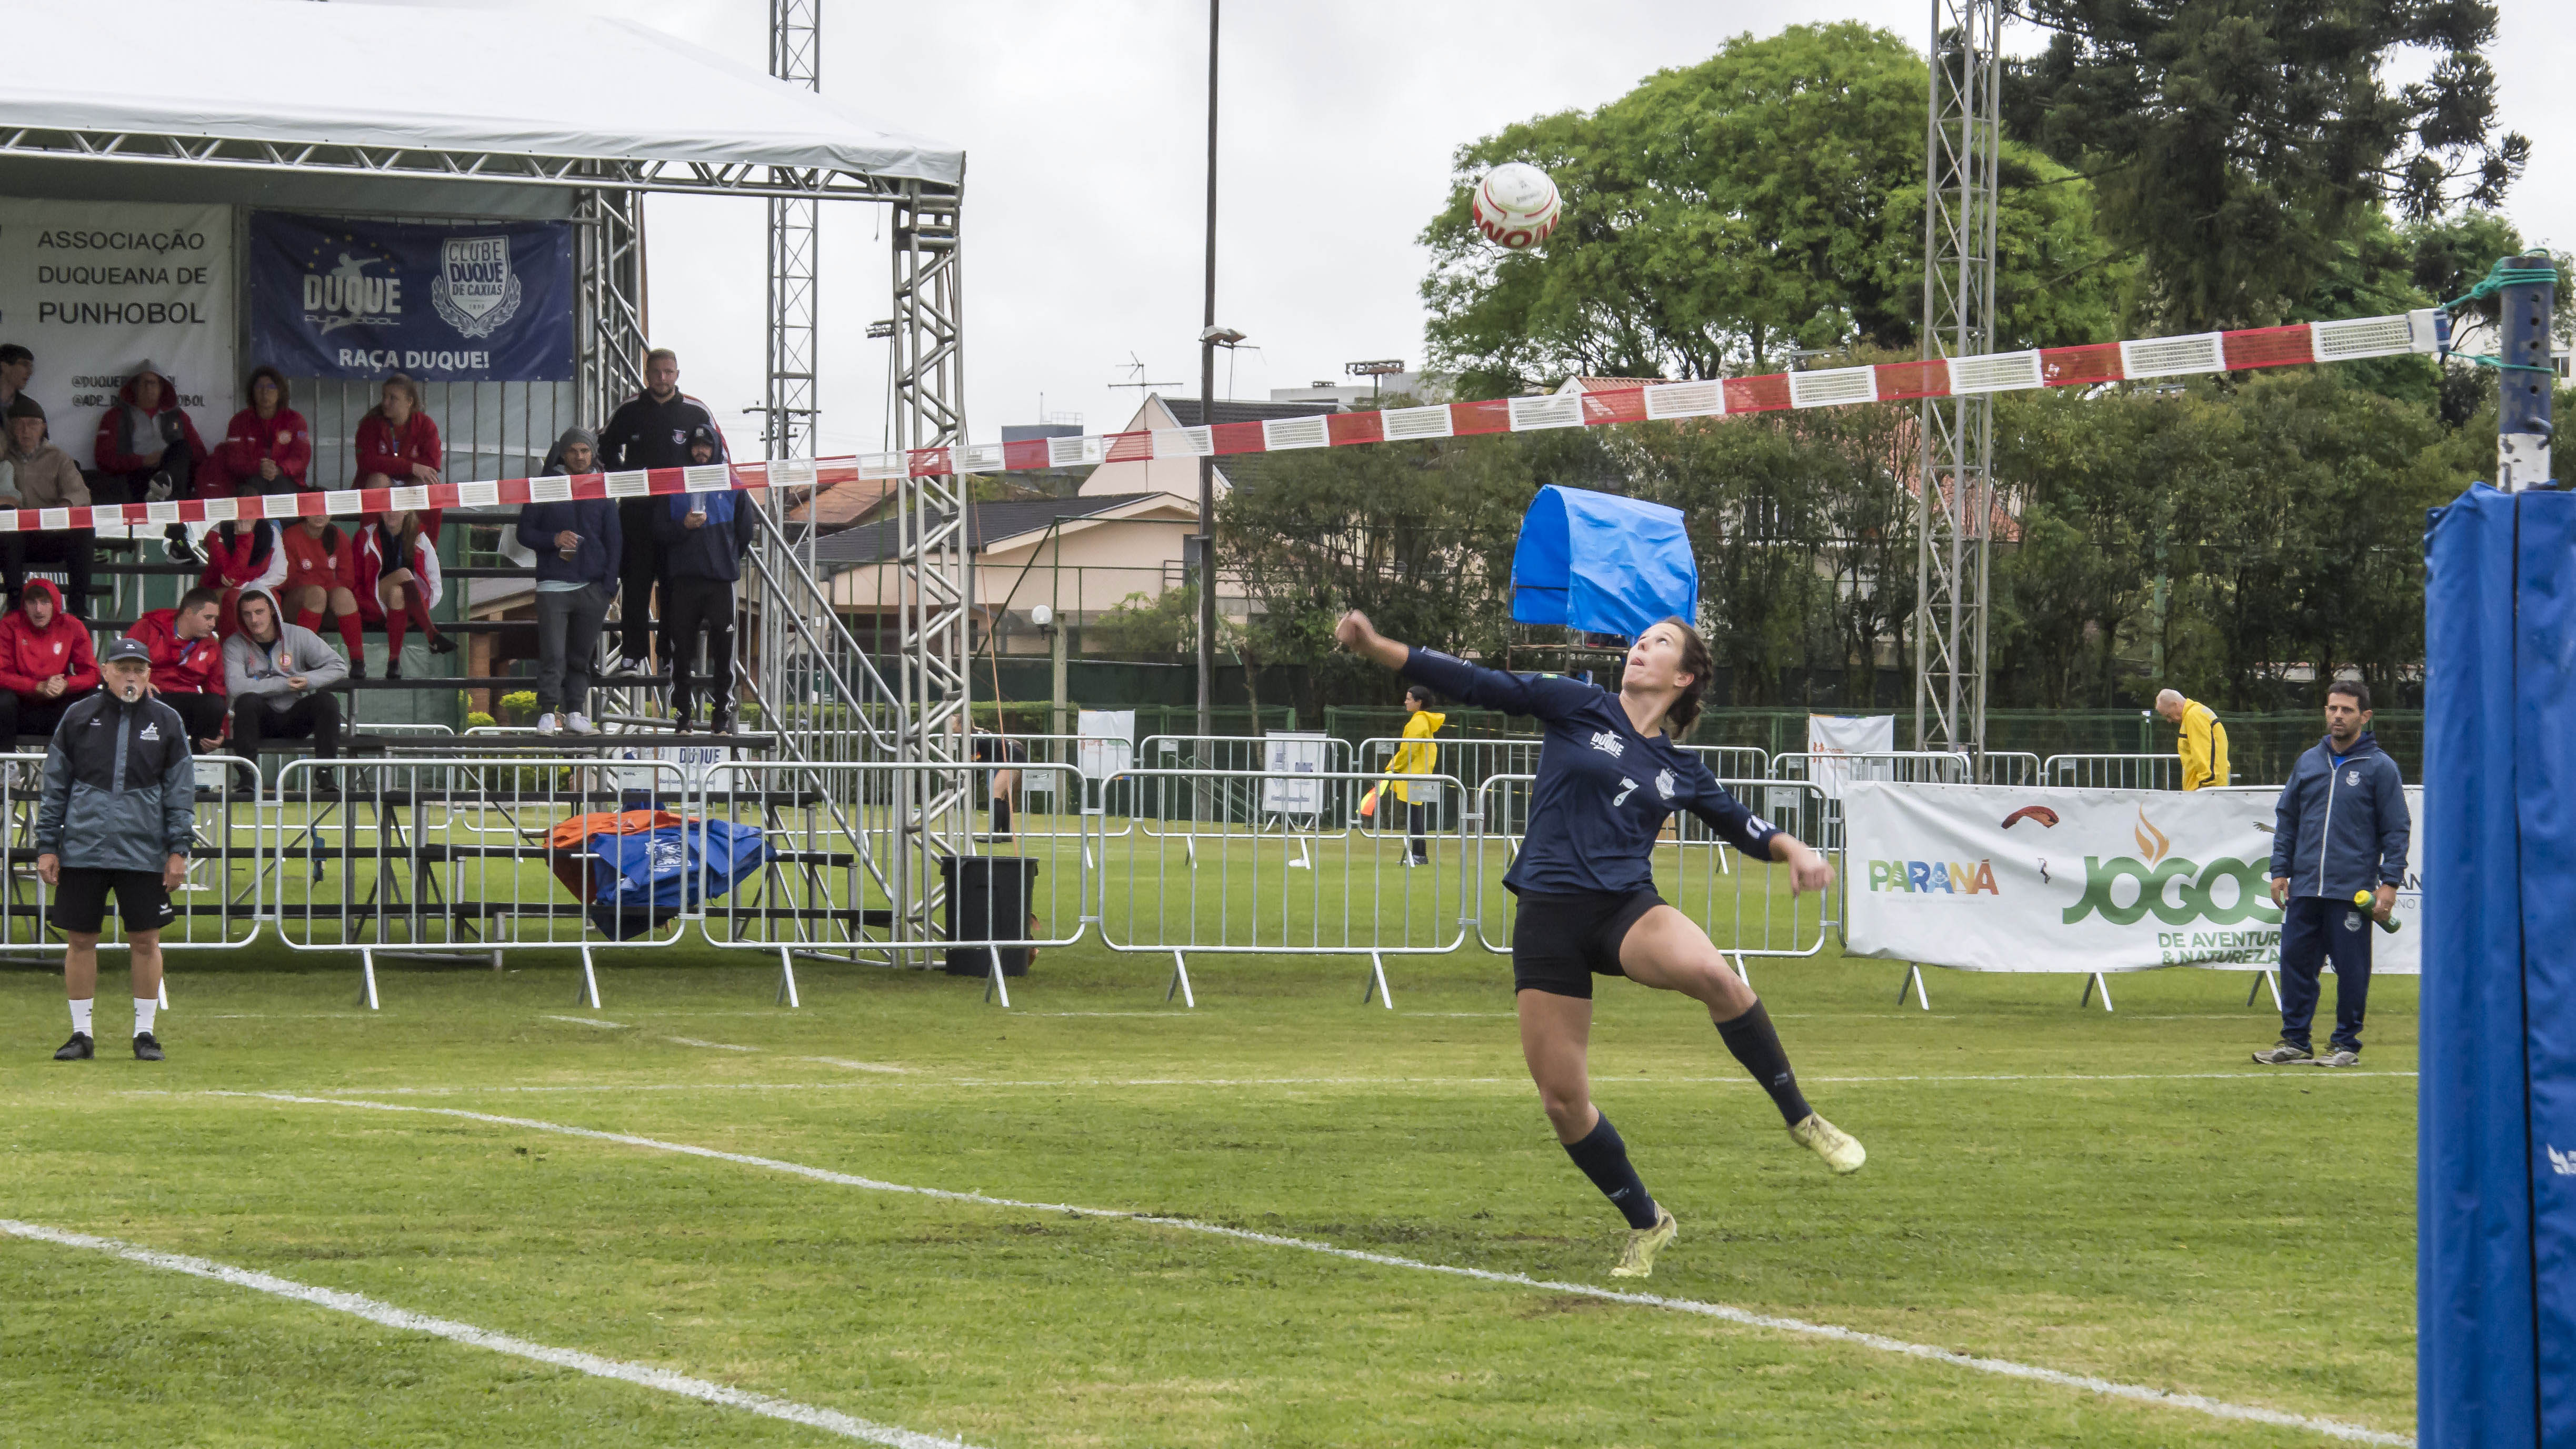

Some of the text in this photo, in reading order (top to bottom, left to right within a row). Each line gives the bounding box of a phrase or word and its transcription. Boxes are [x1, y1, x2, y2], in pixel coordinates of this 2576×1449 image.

[37, 229, 205, 254] ASSOCIAÇÃO
[449, 242, 502, 261] CLUBE
[38, 266, 207, 285] DUQUEANA DE
[450, 262, 503, 283] DUQUE
[304, 274, 401, 315] DUQUE
[453, 284, 503, 296] DE CAXIAS
[38, 302, 205, 324] PUNHOBOL
[339, 348, 490, 373] RAÇA DUQUE!
[1591, 732, 1624, 756] DUQUE
[1613, 776, 1639, 806] 7
[1869, 859, 2000, 895] PARANÁ
[2063, 856, 2285, 926] JOGOS
[2159, 931, 2282, 947] DE AVENTUR
[2162, 949, 2175, 965] &
